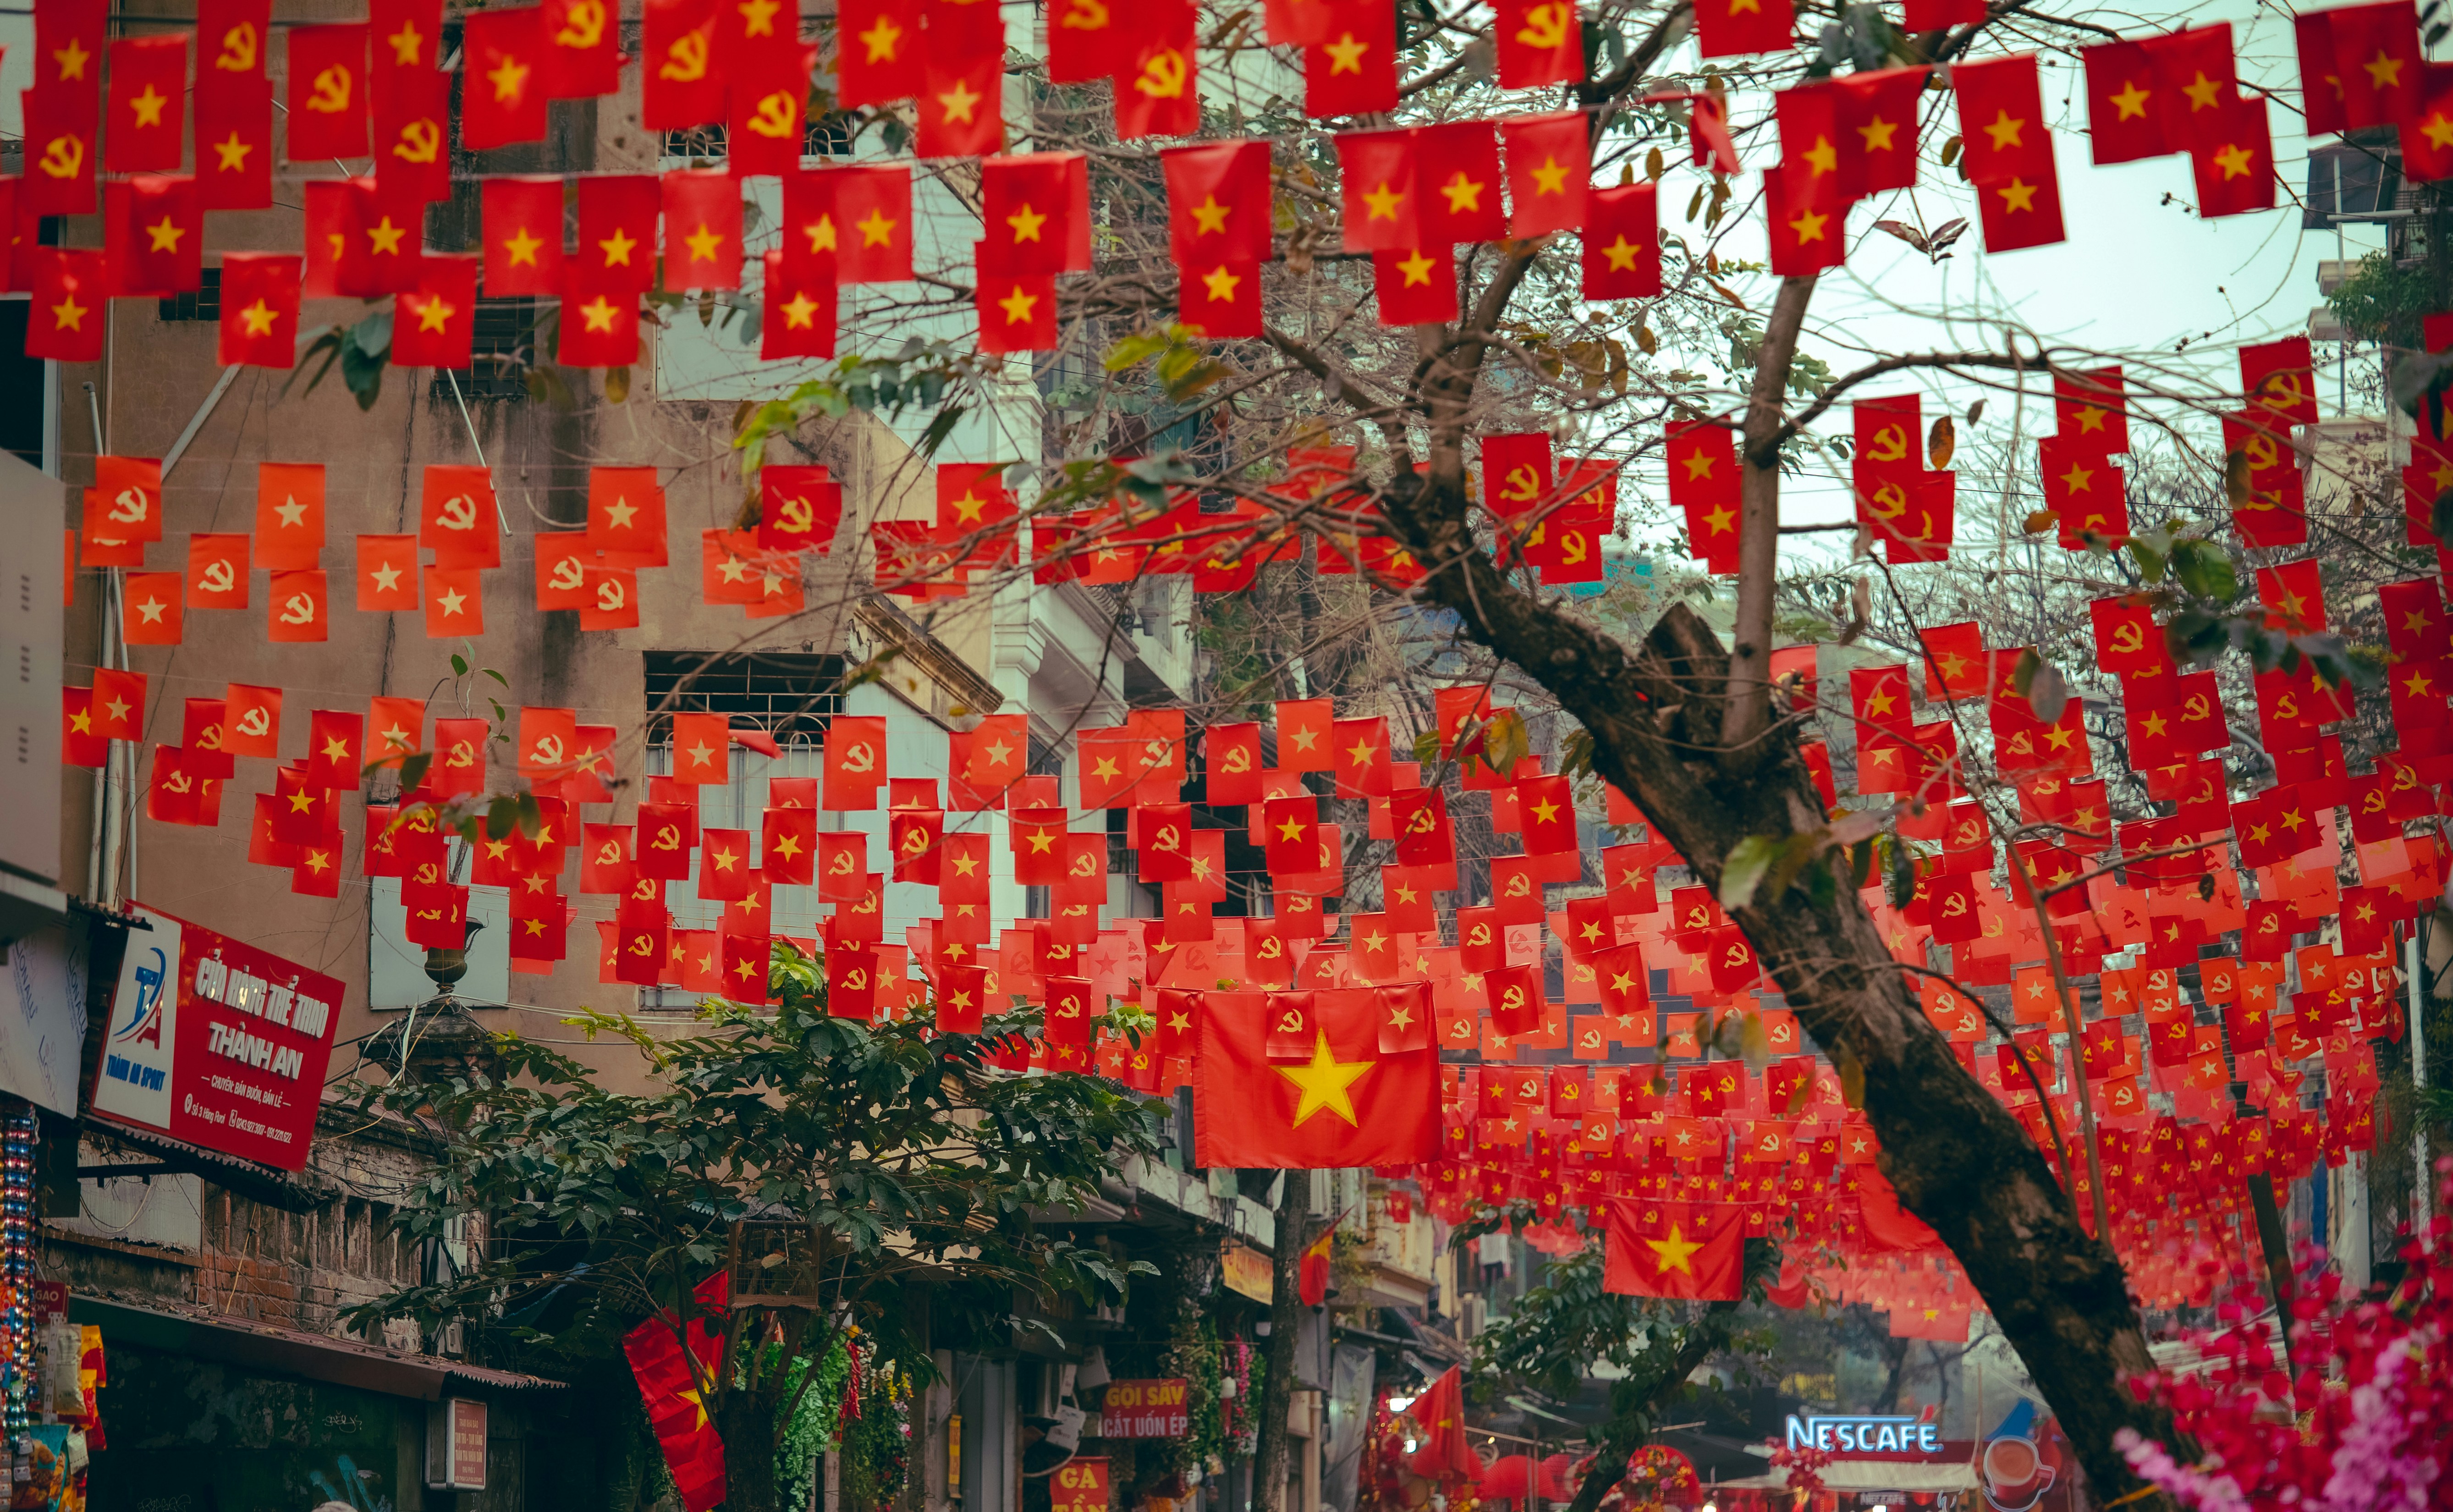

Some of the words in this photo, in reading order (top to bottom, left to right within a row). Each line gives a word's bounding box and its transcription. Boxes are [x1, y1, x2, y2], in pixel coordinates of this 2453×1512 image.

[196, 948, 227, 1003] CỬA
[224, 964, 268, 1017] HÀNG
[264, 975, 299, 1026] THỂ
[291, 993, 329, 1039] THAO
[209, 1021, 274, 1070] THÀNH
[270, 1046, 303, 1080] AN
[106, 1053, 130, 1082] THÀNH
[129, 1062, 142, 1085] AN
[141, 1066, 166, 1092] SPORT
[234, 1080, 246, 1097] BÁN
[262, 1089, 274, 1106] BÁN
[274, 1091, 283, 1108] LẺ
[191, 1102, 199, 1116] Số
[198, 1107, 203, 1118] 3
[203, 1107, 214, 1124] Hàng
[1106, 1383, 1142, 1409] GỘI
[1147, 1380, 1185, 1405] SẤY
[1103, 1410, 1131, 1437] CẮT
[1135, 1410, 1165, 1436] UỐN
[1169, 1412, 1188, 1436] ÉP
[1059, 1463, 1099, 1489] GÀ
